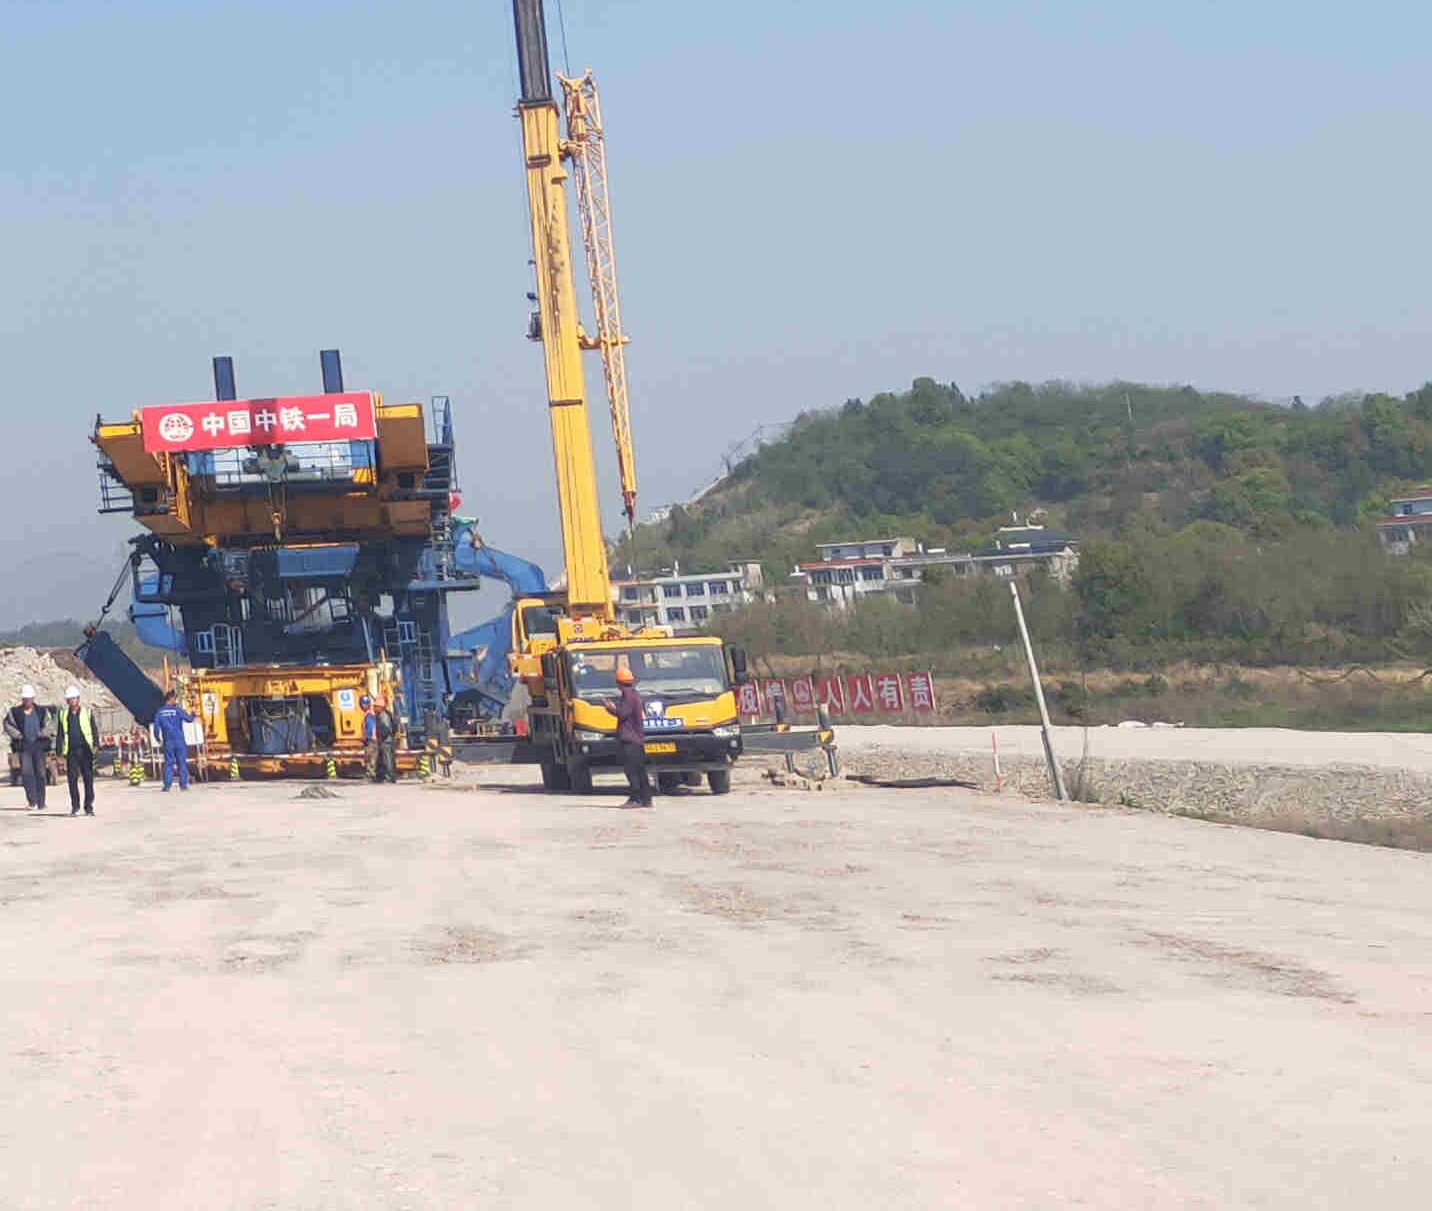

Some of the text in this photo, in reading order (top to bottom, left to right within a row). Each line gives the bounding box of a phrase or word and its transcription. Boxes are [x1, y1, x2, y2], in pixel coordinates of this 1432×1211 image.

[201, 403, 358, 437] 中国中铁一局
